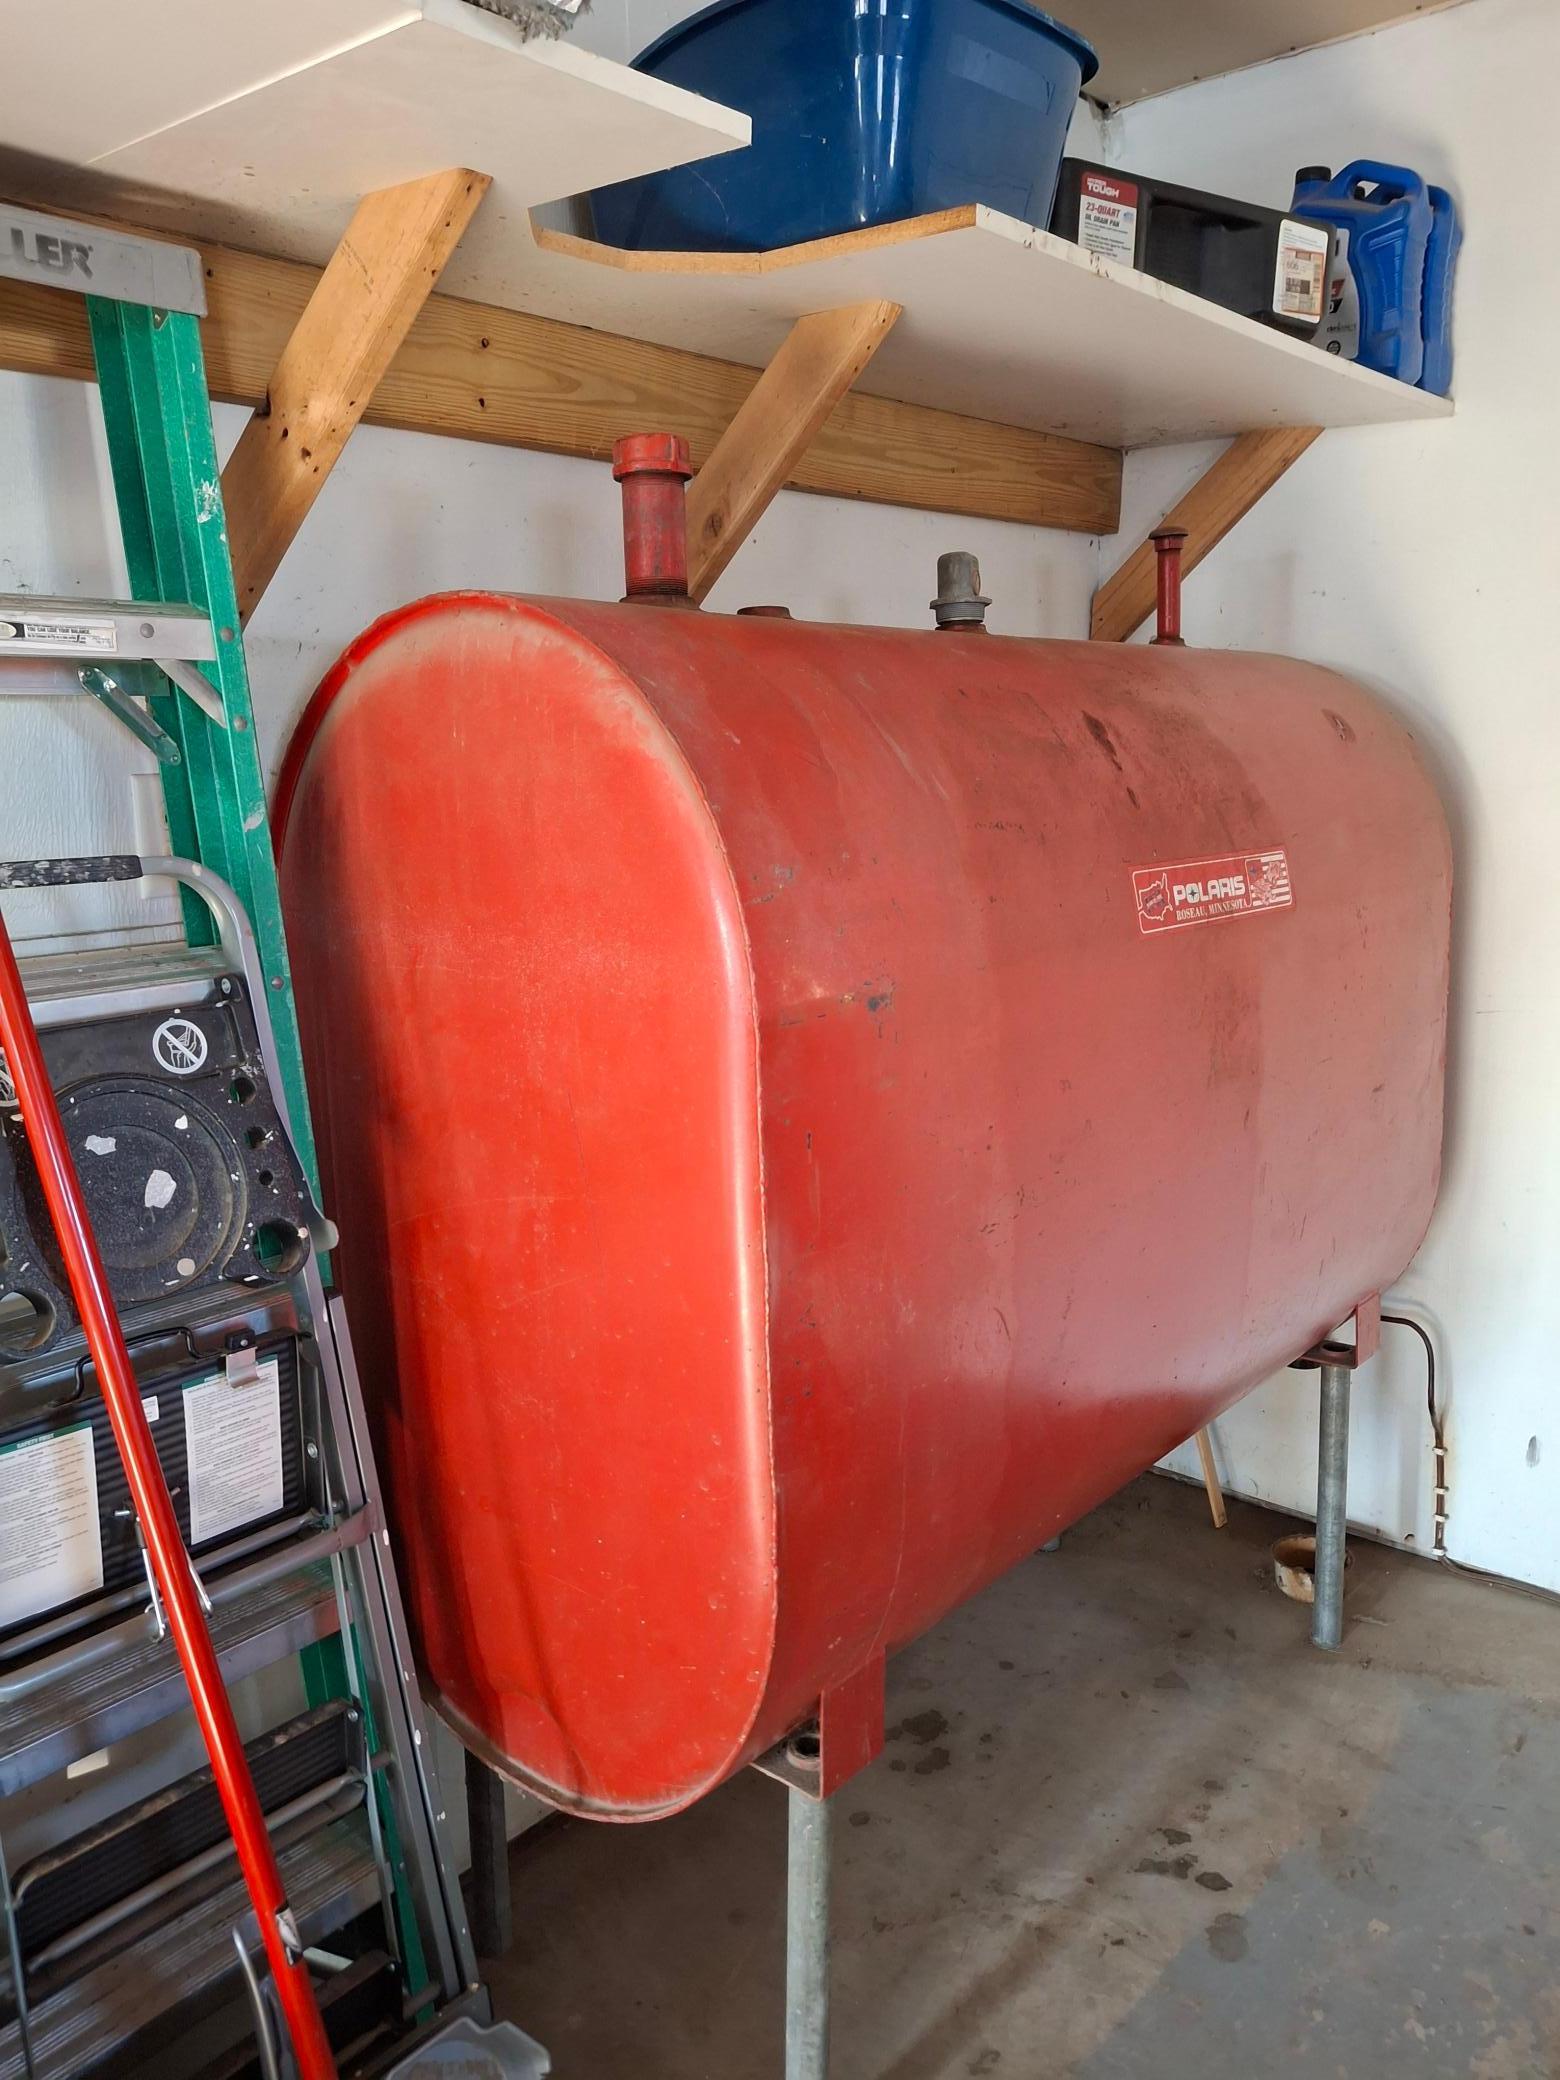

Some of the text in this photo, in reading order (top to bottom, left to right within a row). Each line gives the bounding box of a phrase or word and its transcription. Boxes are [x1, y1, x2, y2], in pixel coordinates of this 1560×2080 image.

[1087, 182, 1120, 198] TOUGH
[1086, 202, 1120, 218] 23-QUART
[1173, 875, 1246, 905] POLARIS
